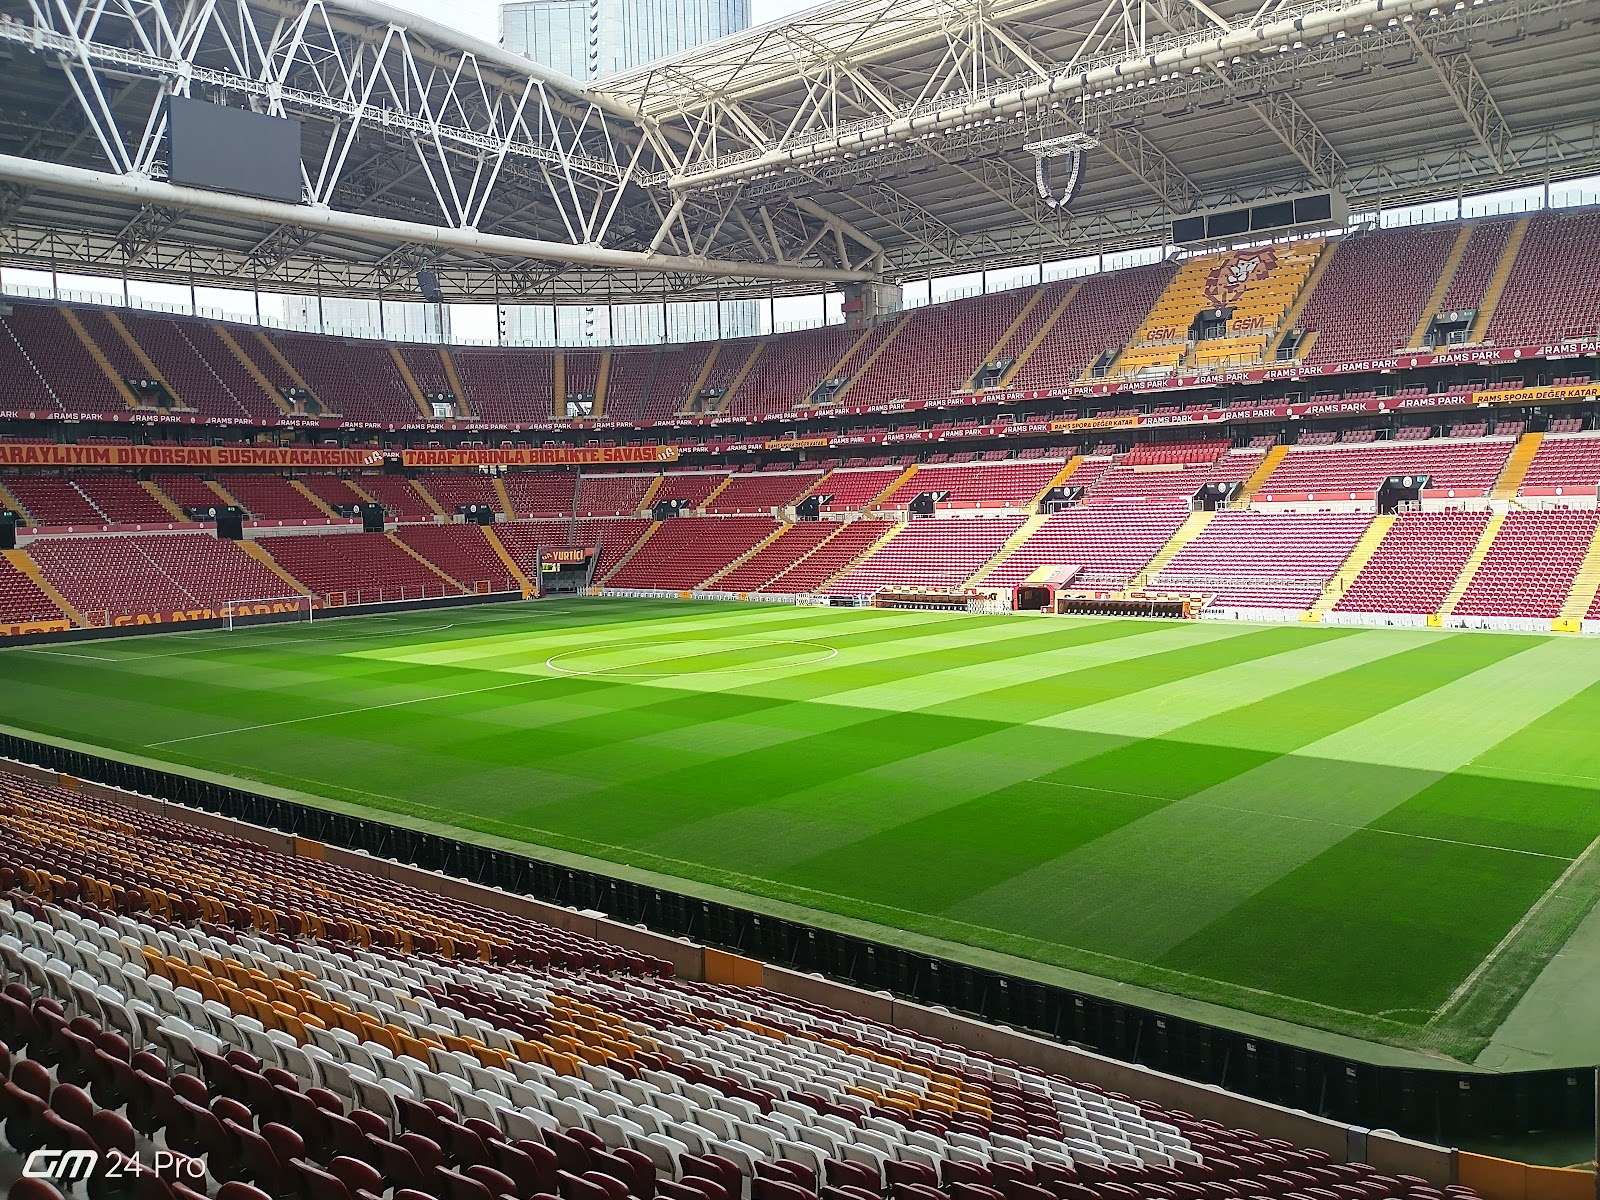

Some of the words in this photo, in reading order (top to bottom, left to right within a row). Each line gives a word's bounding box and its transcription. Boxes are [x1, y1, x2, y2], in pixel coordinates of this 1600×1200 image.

[1232, 317, 1264, 331] GSM
[1146, 328, 1175, 340] GSM
[1545, 344, 1577, 355] RAMS
[1581, 341, 1600, 352] PAR
[1440, 353, 1468, 364] RAMS
[1472, 351, 1500, 361] PARK
[1342, 361, 1369, 371] RAMS
[1372, 359, 1398, 369] PARK
[1201, 375, 1223, 384] RAMS
[1227, 372, 1249, 382] PARK
[1271, 369, 1296, 378] RAMS
[1299, 366, 1323, 376] PARK
[1123, 381, 1144, 391] RAMS
[1147, 379, 1168, 389] PARK
[986, 394, 1004, 403] RAMS
[1007, 392, 1025, 401] PARK
[1052, 389, 1072, 397] RAMS
[1075, 386, 1093, 395] PARK
[1478, 394, 1502, 403] RAMS
[1503, 392, 1534, 401] SPORA
[1536, 389, 1566, 399] DEĞER
[1568, 388, 1597, 398] KATAR
[871, 404, 888, 412] RAMS
[890, 402, 905, 410] PARK
[948, 397, 964, 405] PARK
[1406, 398, 1435, 407] RAMS
[1438, 395, 1466, 405] PARK
[835, 408, 850, 416] PARK
[1312, 404, 1338, 413] RAMS
[1341, 402, 1367, 411] PARK
[1148, 416, 1170, 425] RAMS
[1172, 414, 1193, 423] PARK
[1226, 411, 1250, 420] RAMS
[1253, 408, 1276, 418] PARK
[1008, 425, 1027, 433] RAMS
[1072, 421, 1091, 429] SPORA
[888, 433, 904, 441] RAMS
[906, 431, 922, 439] PARK
[946, 429, 963, 437] RAMS
[966, 428, 982, 436] PARK
[0, 447, 110, 464] ARAYLIYIM
[118, 447, 212, 464] DİYORSAN
[218, 450, 363, 465] SUSMAYACAKSIN!
[406, 451, 526, 465] TARAFTARINLA
